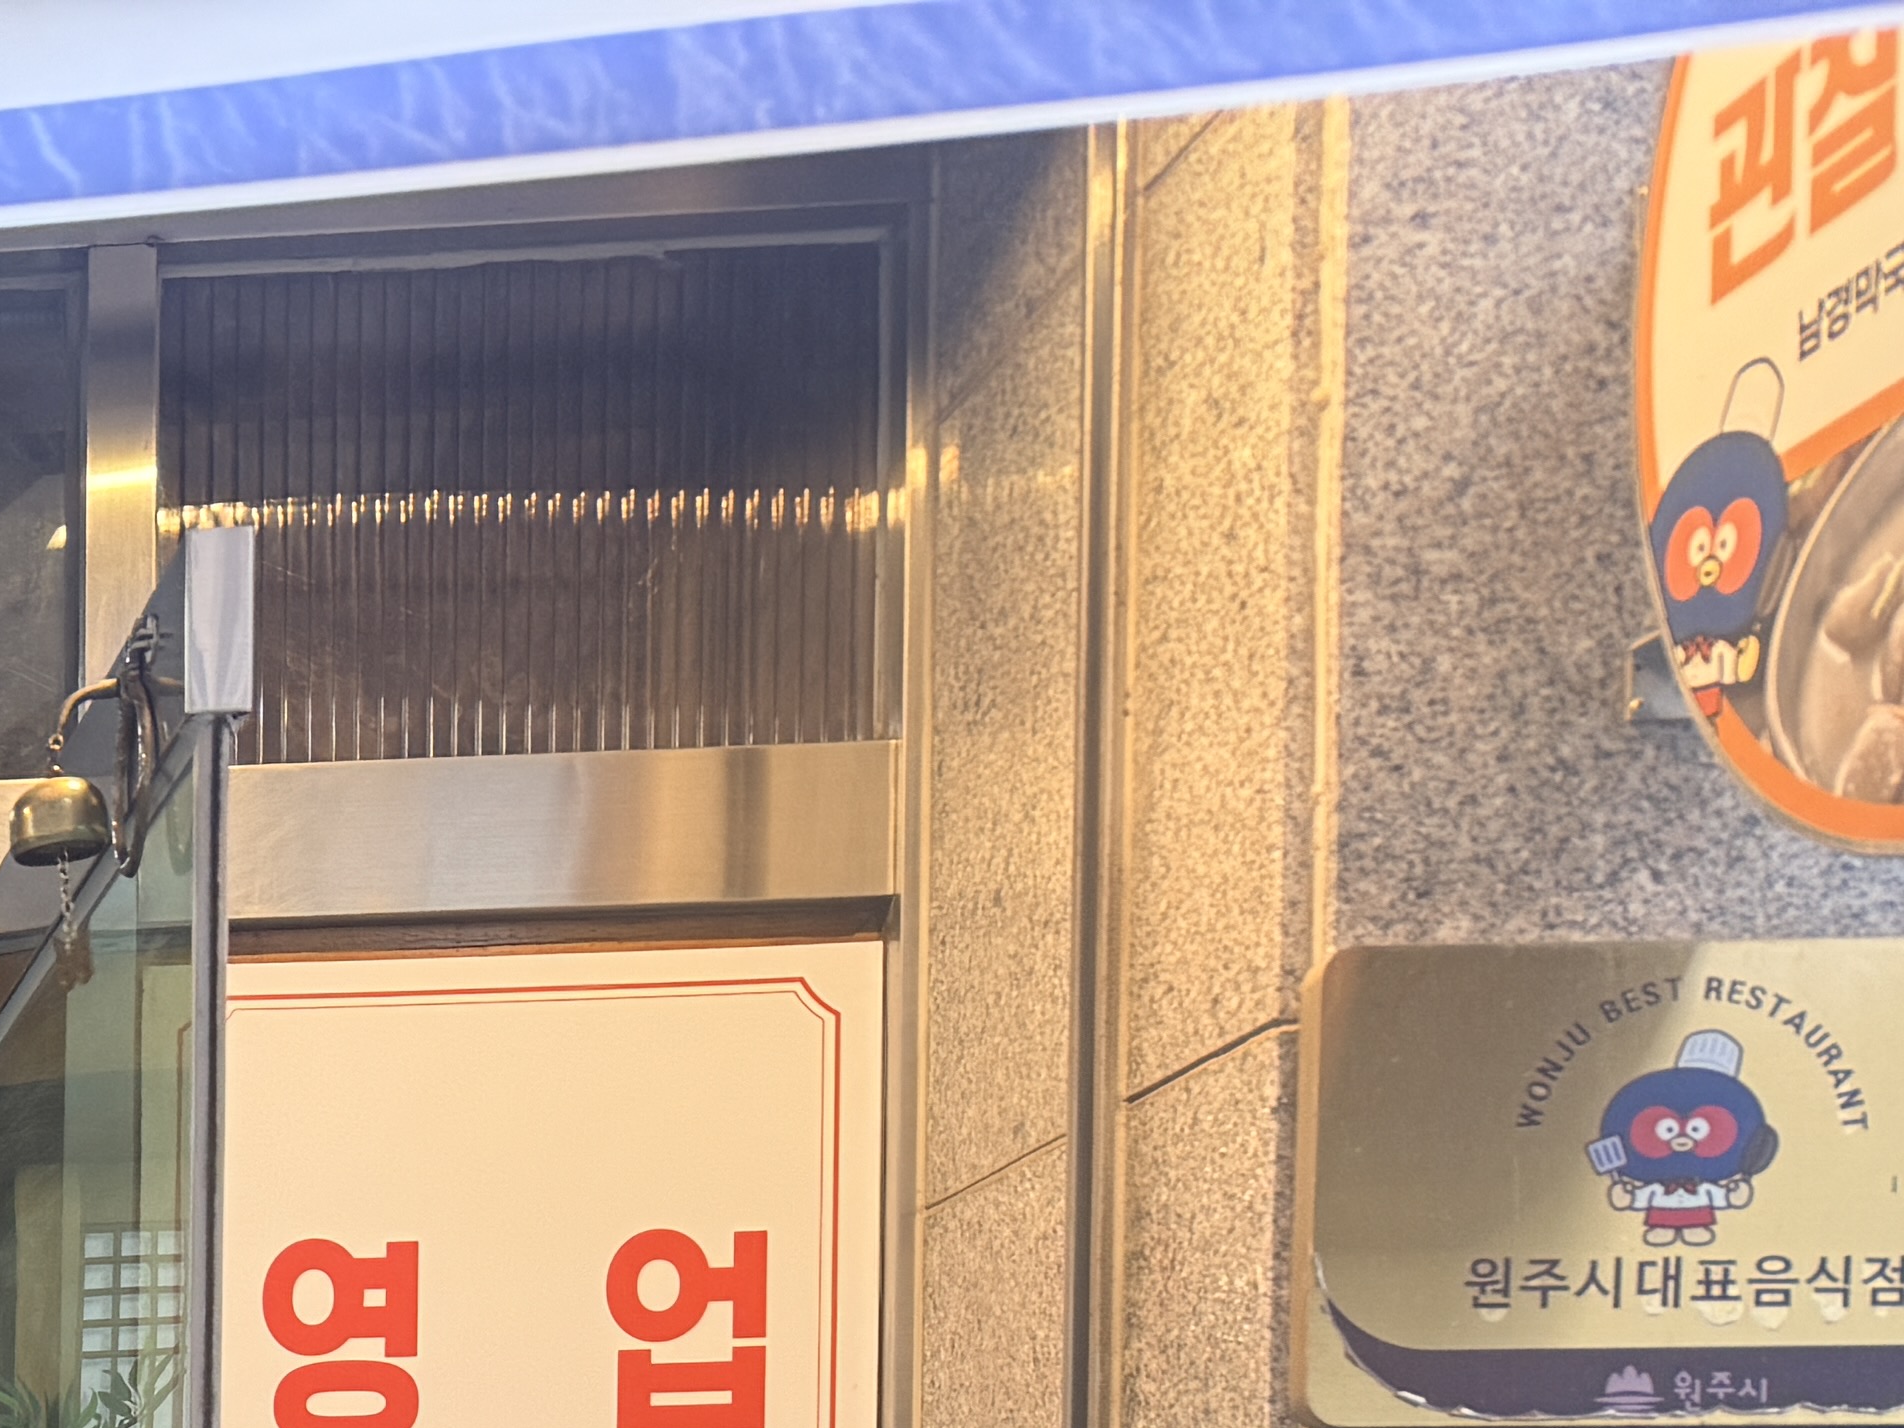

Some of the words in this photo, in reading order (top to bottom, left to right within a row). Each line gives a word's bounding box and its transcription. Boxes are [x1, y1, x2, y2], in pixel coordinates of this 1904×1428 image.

[1516, 1021, 1592, 1130] WONJU
[1599, 975, 1684, 1024] BEST
[1704, 975, 1869, 1132] RESTAURANT
[1464, 1254, 1904, 1311] 원주시대표음식점
[1673, 1370, 1768, 1411] 원주시
